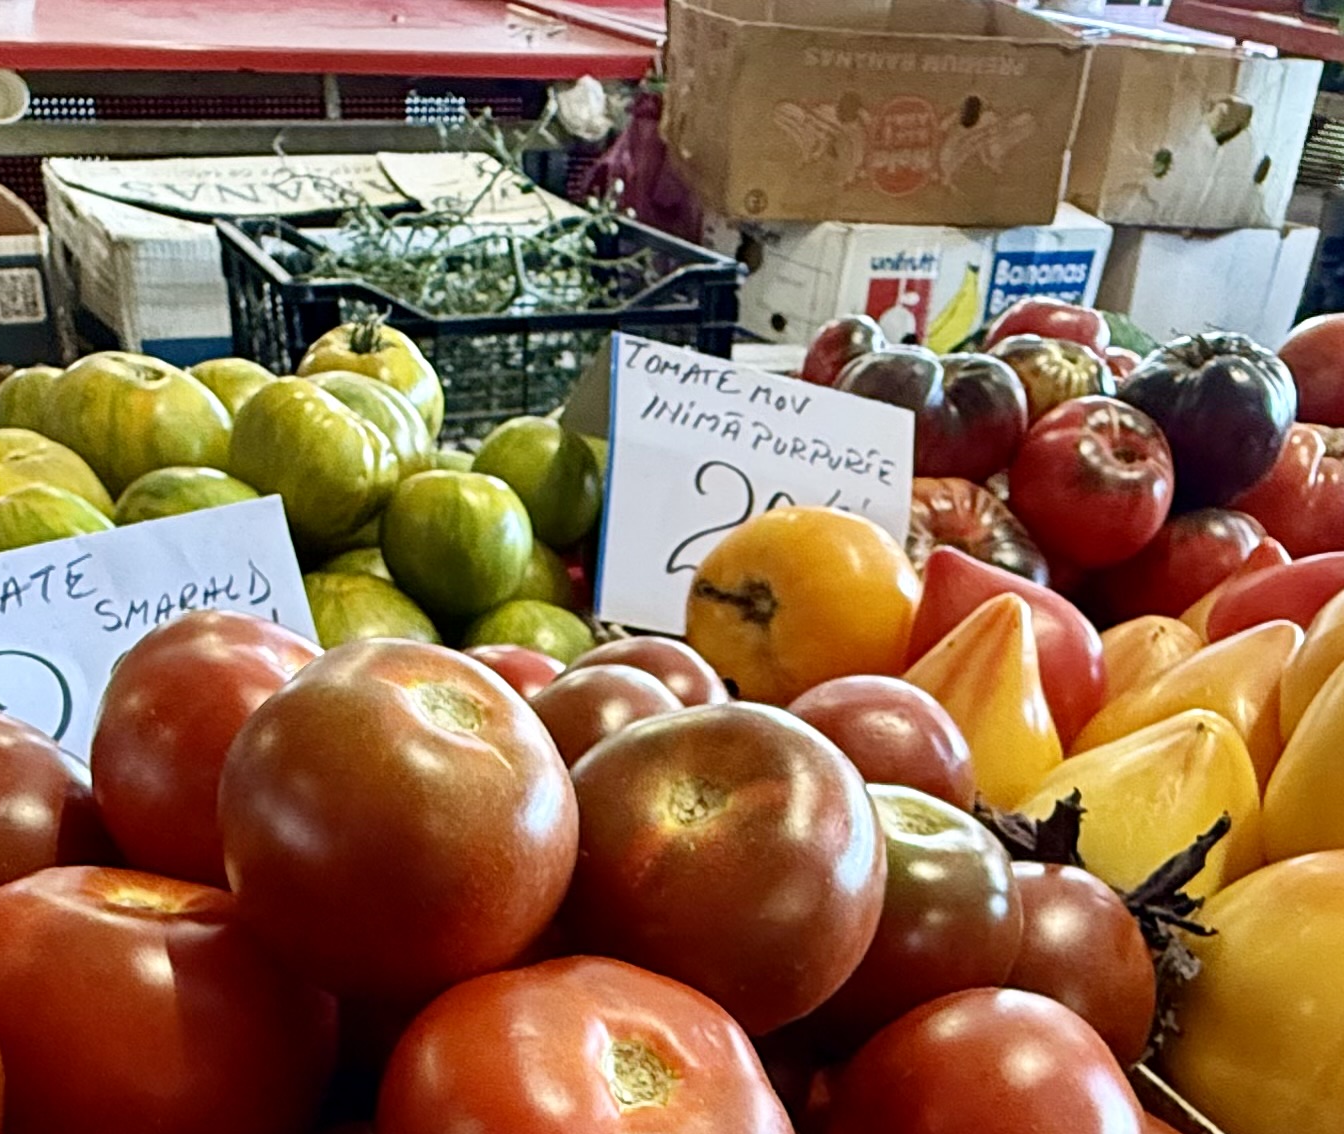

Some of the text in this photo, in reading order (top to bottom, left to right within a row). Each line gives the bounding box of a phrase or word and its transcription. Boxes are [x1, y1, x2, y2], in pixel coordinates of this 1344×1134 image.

[995, 259, 1088, 285] Bananas
[624, 340, 811, 415] TOMATE MOV
[666, 461, 796, 574] 2
